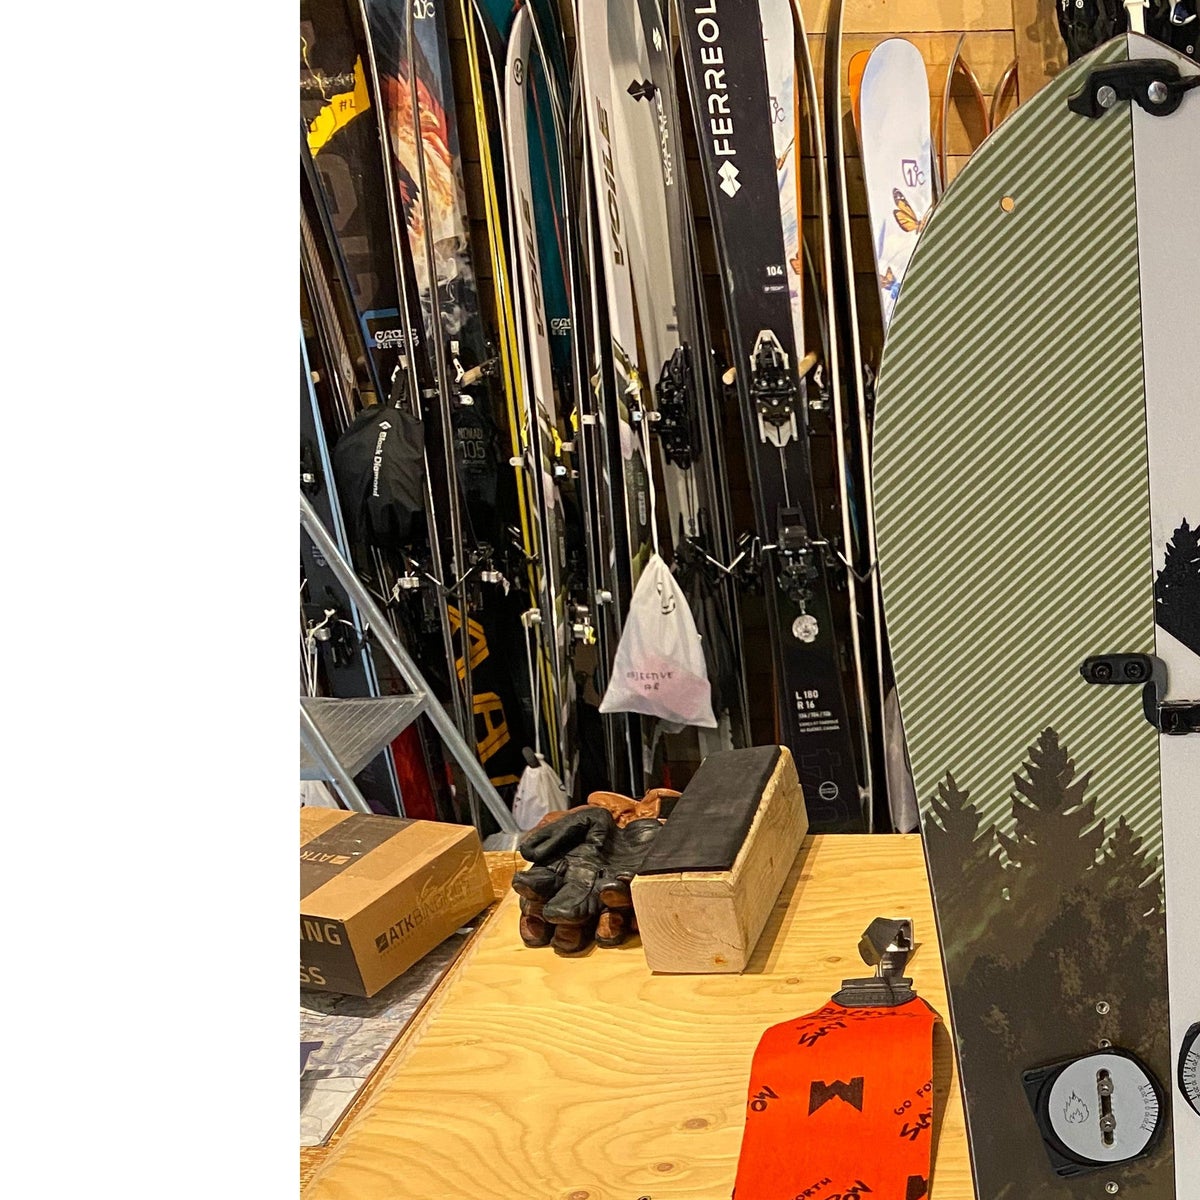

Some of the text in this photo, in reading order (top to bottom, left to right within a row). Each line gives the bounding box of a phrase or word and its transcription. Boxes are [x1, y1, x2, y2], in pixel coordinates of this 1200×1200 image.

[695, 0, 736, 156] FERREOL
[766, 266, 783, 276] 104
[460, 440, 486, 459] 105
[372, 431, 388, 498] Black Diamond
[795, 690, 819, 700] L 180
[797, 700, 815, 710] R 16
[893, 1099, 913, 1116] GO
